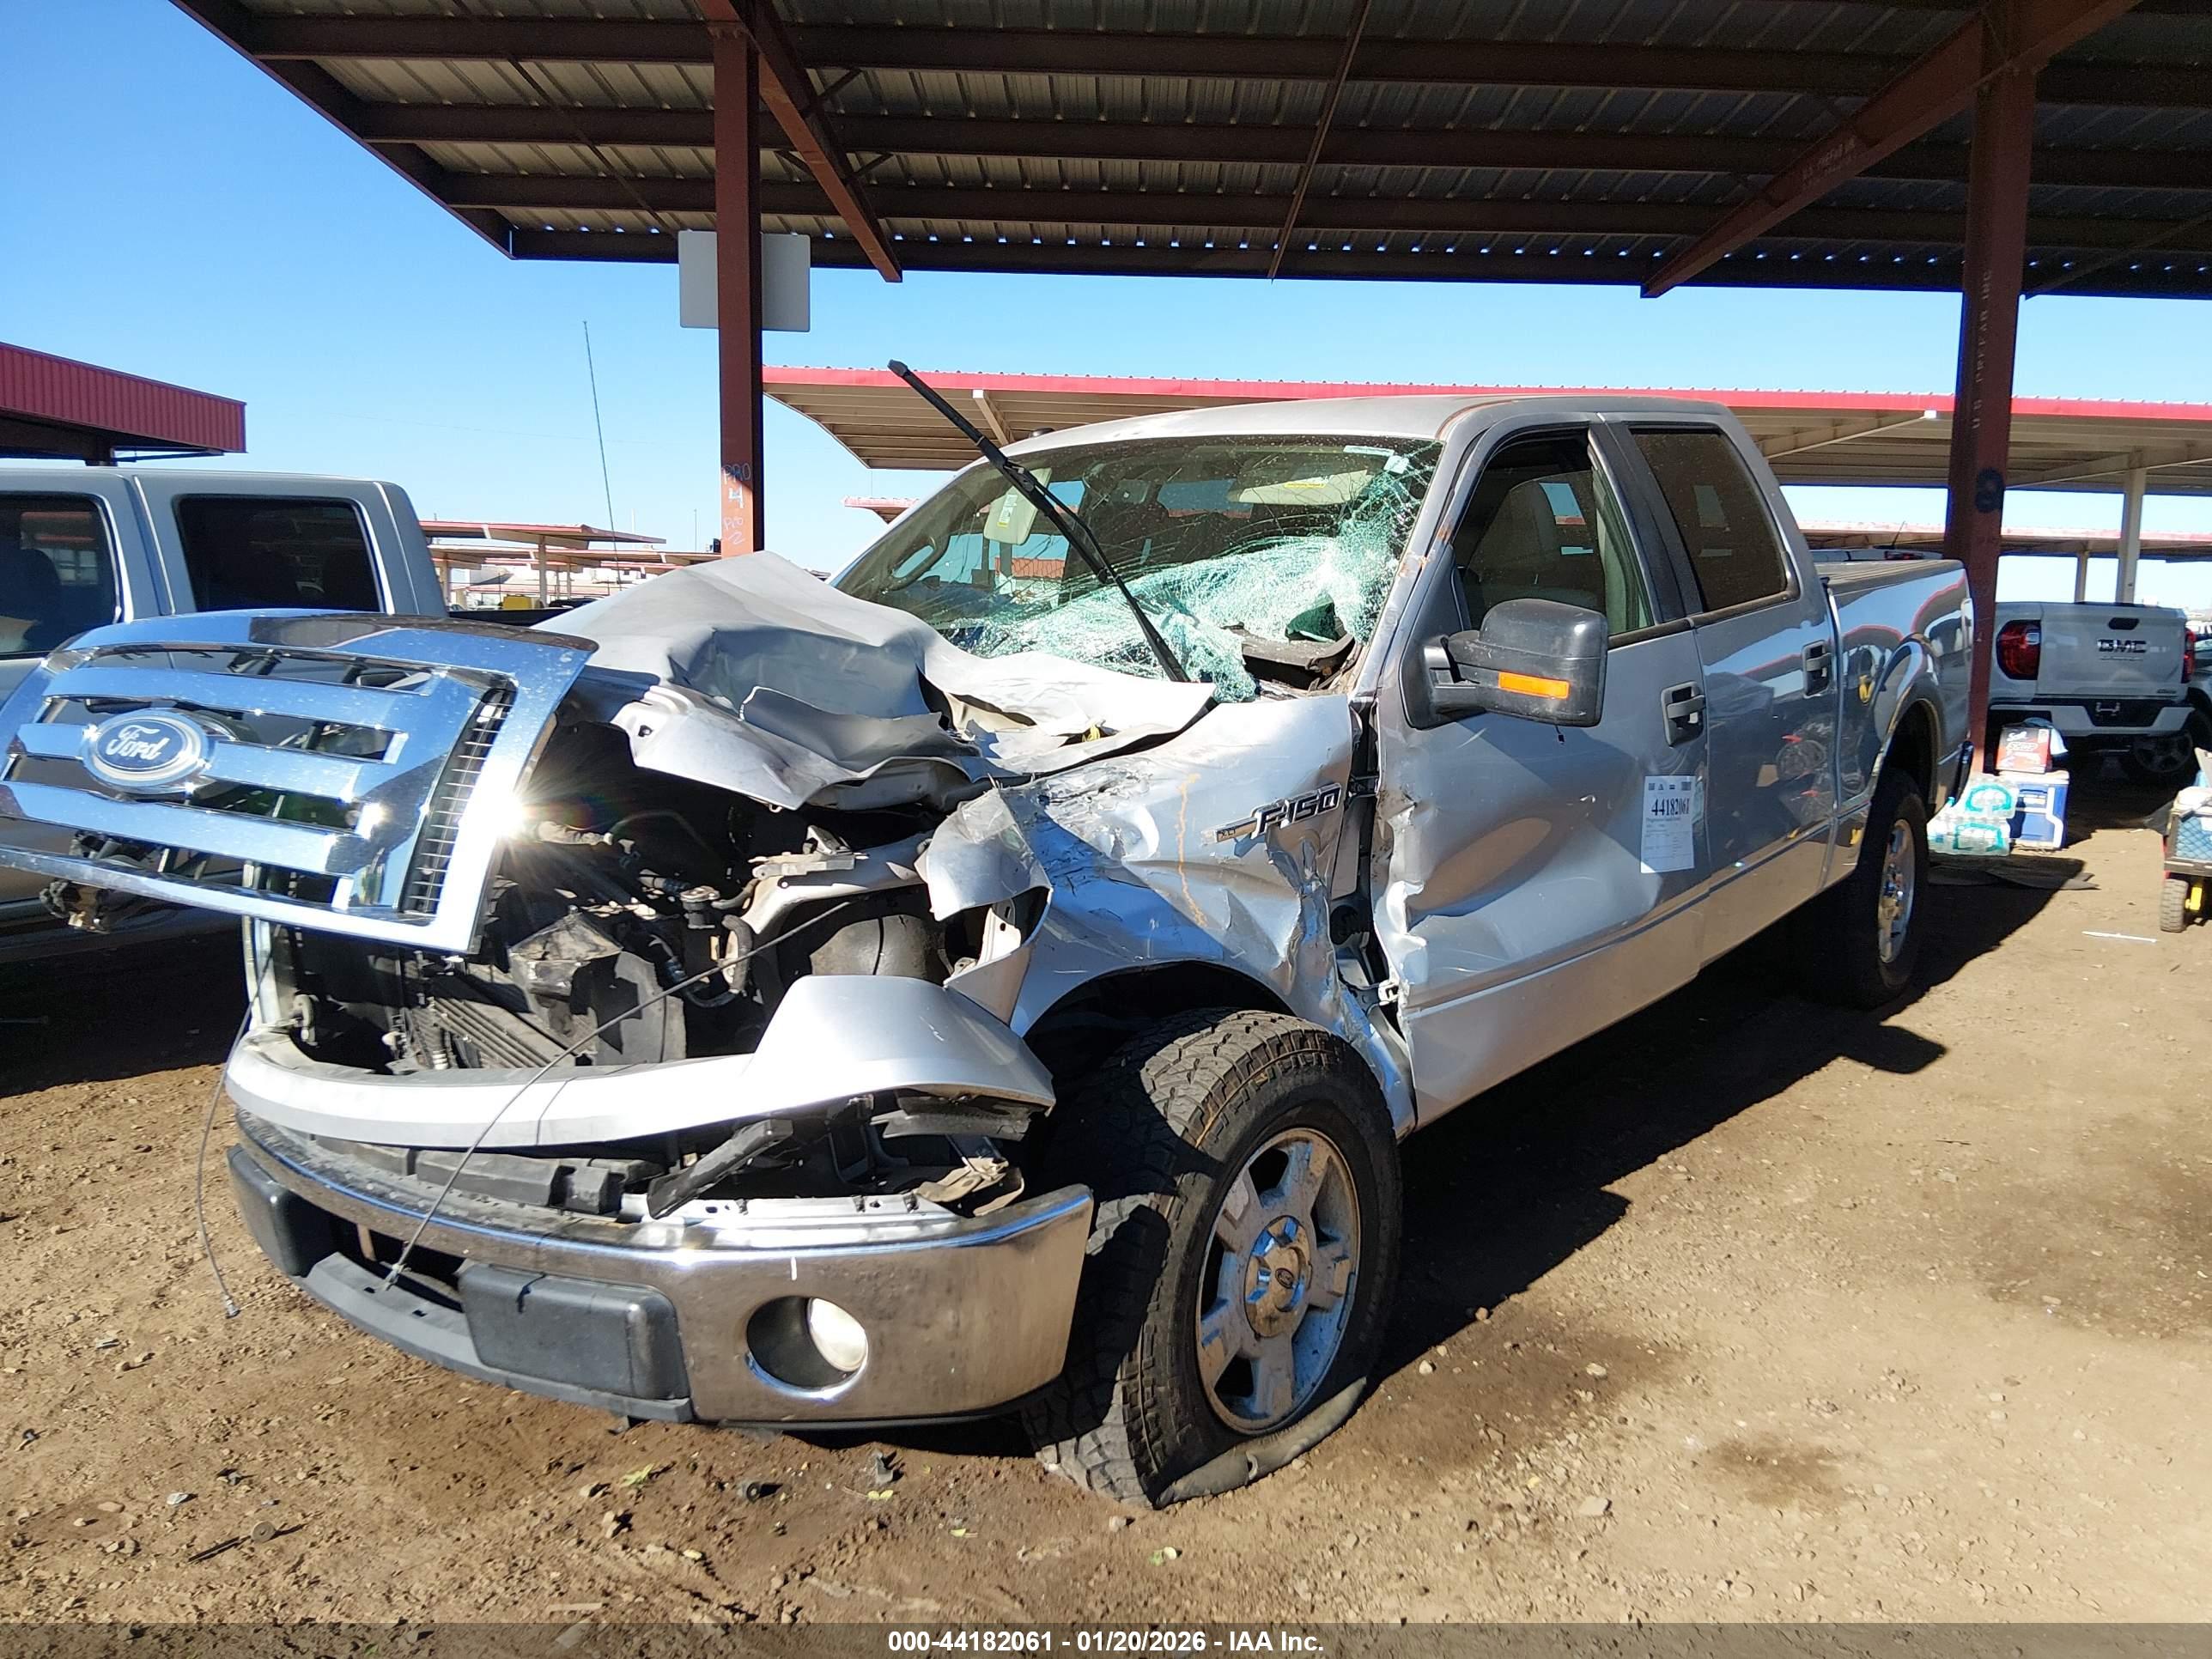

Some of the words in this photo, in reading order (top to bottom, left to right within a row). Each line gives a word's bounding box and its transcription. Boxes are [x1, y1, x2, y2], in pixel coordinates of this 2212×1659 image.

[2097, 640, 2147, 653] GMC
[105, 725, 170, 761] Ford
[1650, 798, 1691, 817] 44182061
